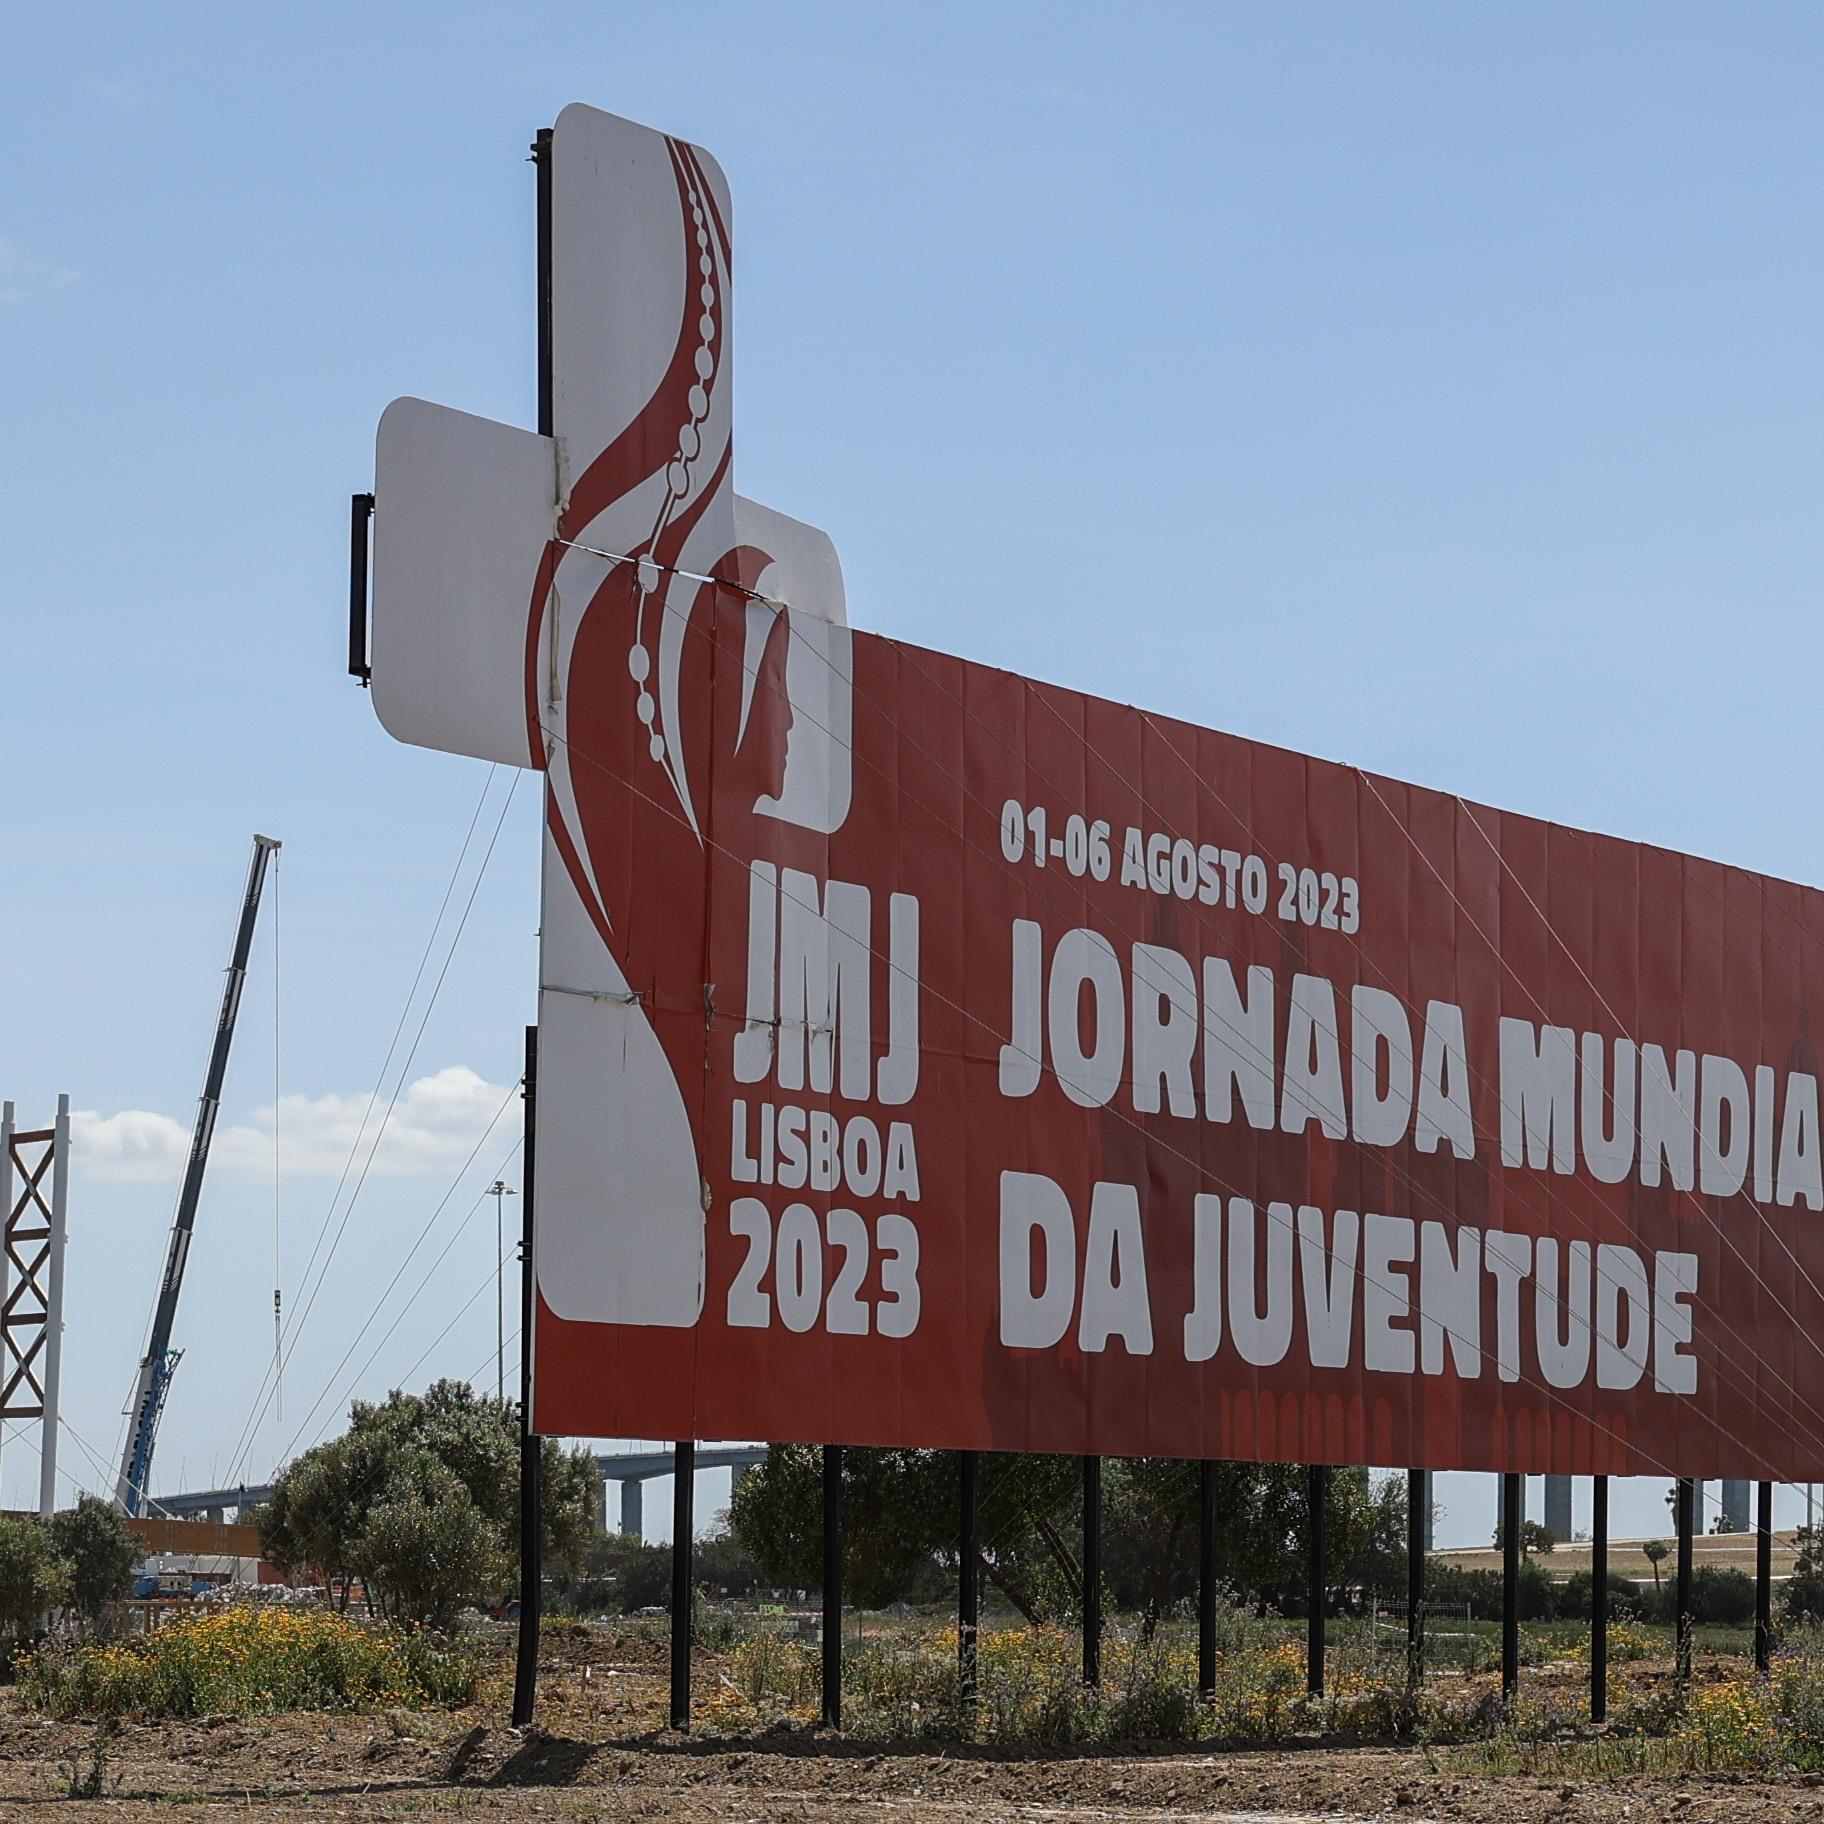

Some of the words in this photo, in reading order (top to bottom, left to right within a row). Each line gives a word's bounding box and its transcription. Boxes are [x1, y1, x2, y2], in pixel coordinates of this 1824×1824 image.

[1001, 799, 1113, 881] 01-06
[1121, 827, 1267, 914] AGOSTO
[1278, 862, 1360, 935] 2023
[732, 860, 920, 1106] JMJ
[998, 918, 1476, 1160] JORNADA
[731, 1098, 921, 1202] LISBOA
[726, 1197, 921, 1338] 2023
[999, 1169, 1154, 1356] DA
[1183, 1192, 1699, 1395] JUVENTUDE
